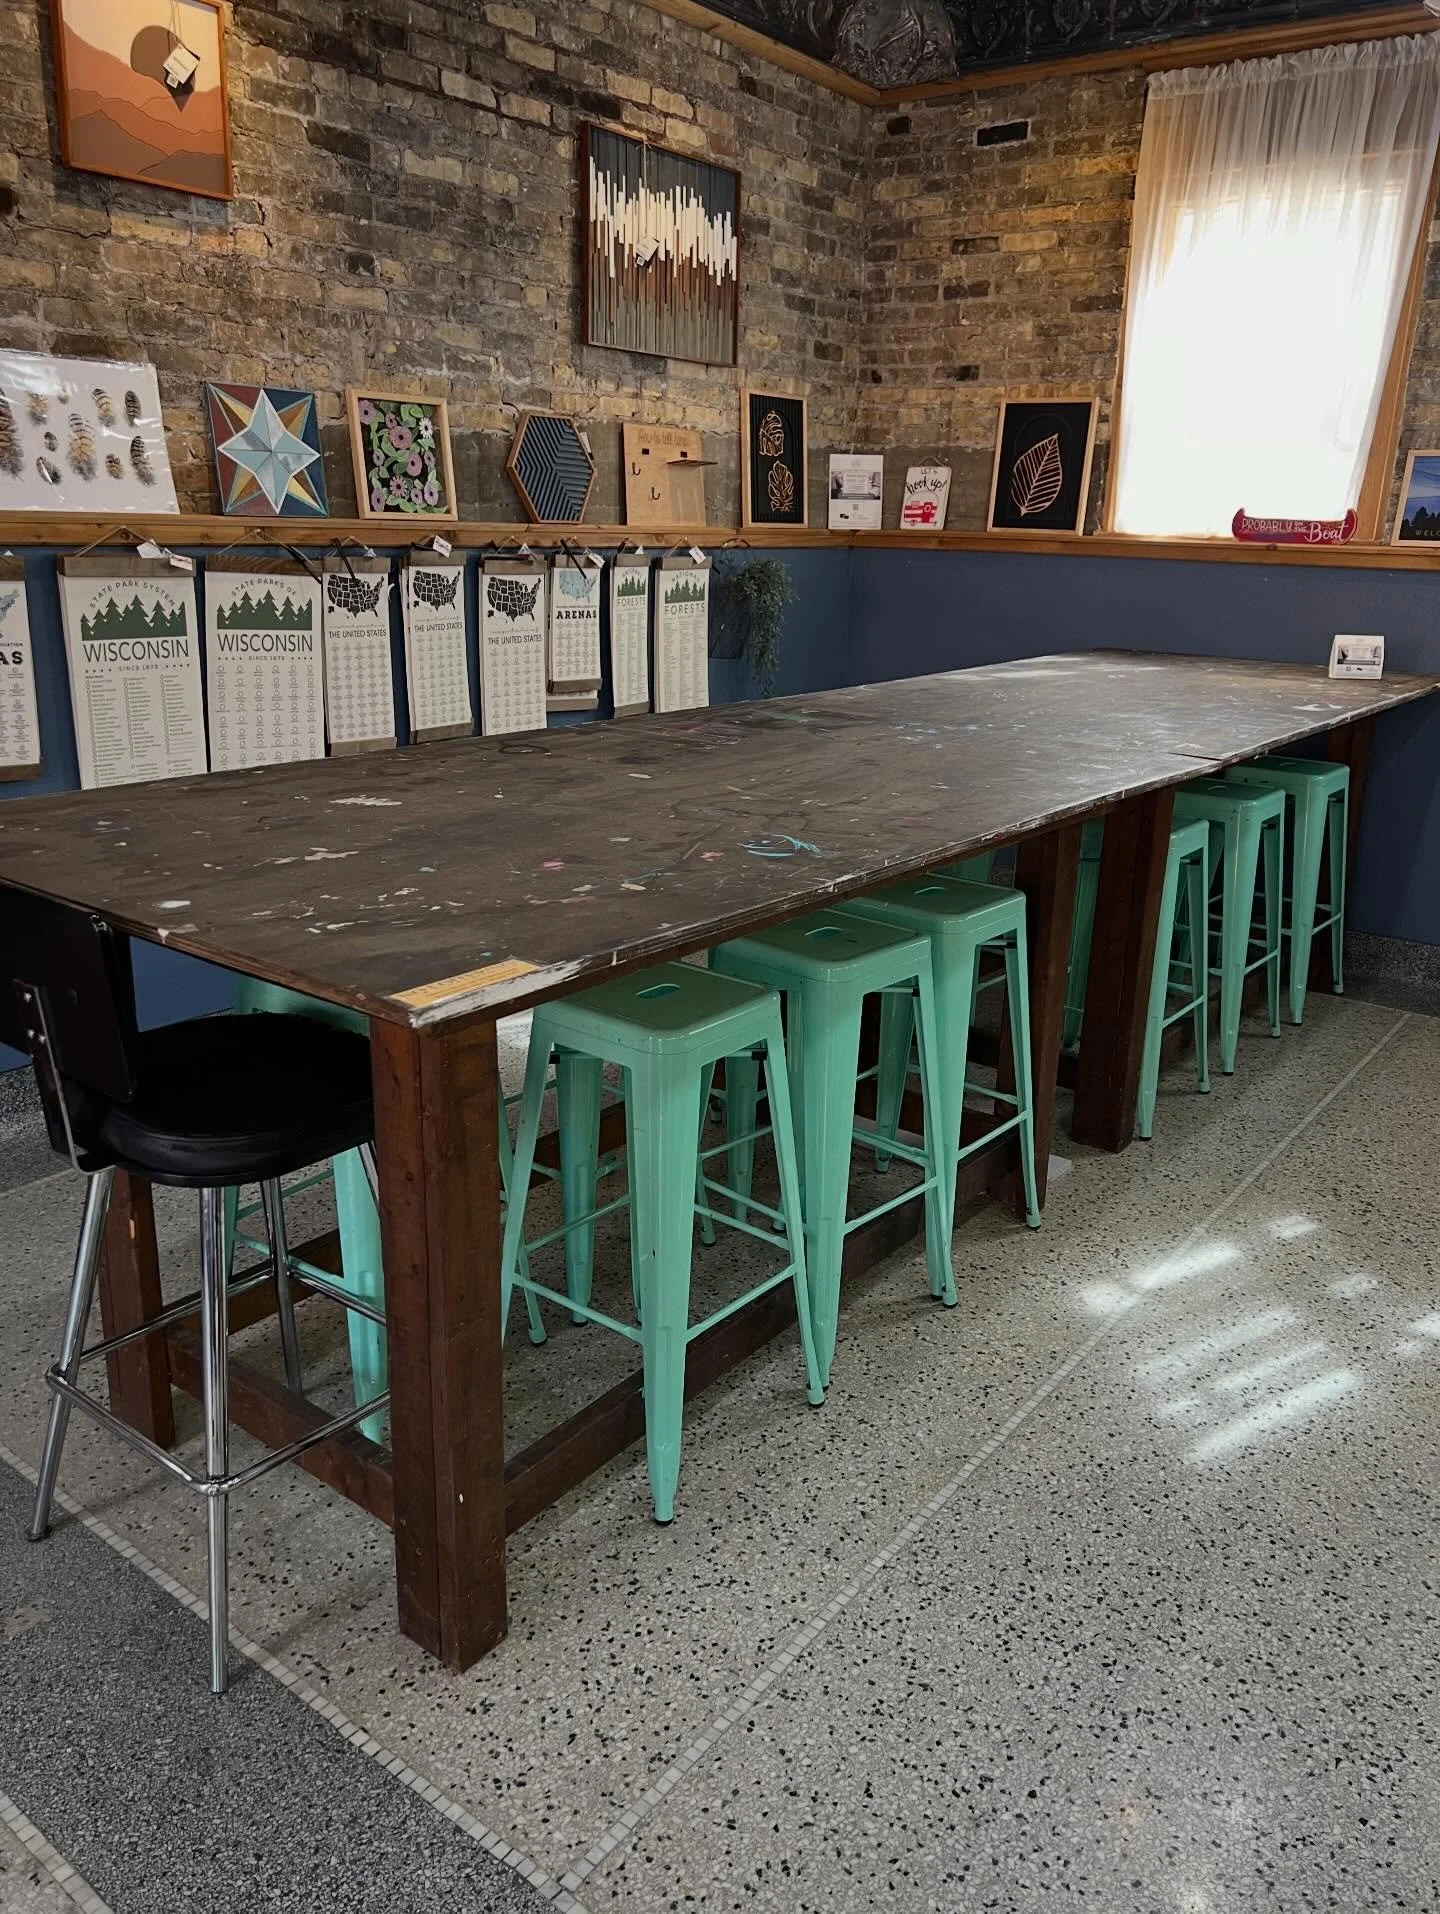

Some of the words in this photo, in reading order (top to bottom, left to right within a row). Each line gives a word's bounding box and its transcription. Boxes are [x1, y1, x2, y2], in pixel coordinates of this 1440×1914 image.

[906, 475, 930, 494] hook
[930, 477, 948, 492] up!
[1241, 518, 1292, 533] PROBABLY
[1304, 521, 1349, 543] Boat
[89, 585, 113, 609] STATE
[115, 579, 141, 589] PARK
[143, 581, 176, 607] SYSTEM
[231, 579, 255, 597] STATE
[257, 578, 285, 589] PARKS
[286, 586, 297, 596] OF
[616, 596, 646, 607] FORESTS
[556, 609, 597, 620] ARENAS
[664, 602, 705, 616] FORESTS
[329, 630, 341, 639] THE
[342, 629, 366, 638] UNITED
[366, 628, 387, 638] STATES
[414, 624, 425, 633] THE
[426, 622, 446, 632] UNITED
[446, 621, 463, 630] STATES
[217, 633, 313, 653] WISCONSIN
[488, 637, 500, 646] THE
[501, 635, 523, 645] UNITED
[523, 633, 543, 643] STATES
[83, 639, 189, 663] WISCONSIN
[118, 665, 140, 673] SINCE
